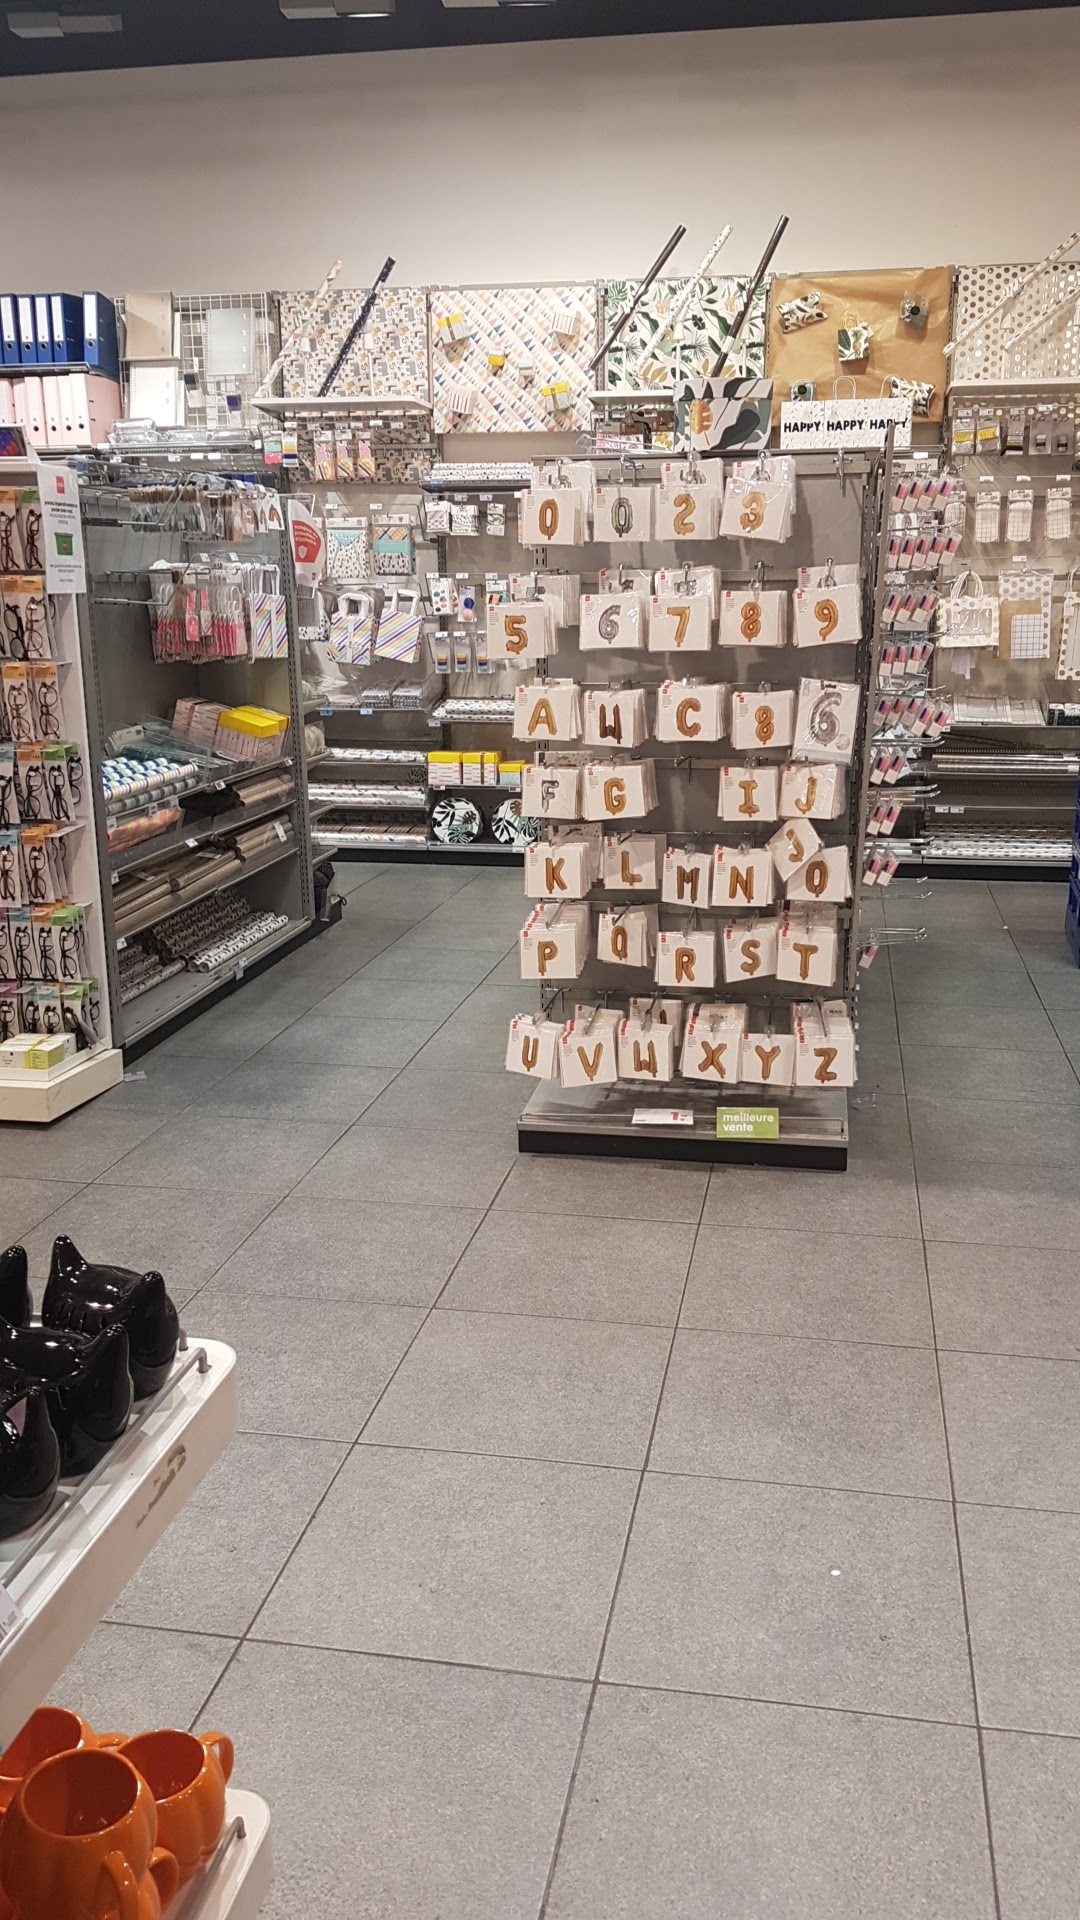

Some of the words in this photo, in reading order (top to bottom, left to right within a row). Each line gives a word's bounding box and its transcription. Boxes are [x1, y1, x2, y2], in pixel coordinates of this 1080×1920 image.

[783, 420, 822, 433] HAPPY
[826, 419, 865, 432] HAPPY
[673, 493, 696, 536] 2
[740, 491, 767, 533] 3
[504, 614, 529, 655] 5
[598, 603, 621, 645] 6
[666, 606, 691, 648] 7
[740, 600, 762, 643] 8
[814, 598, 839, 642] 9
[528, 697, 558, 736] A
[676, 697, 702, 738] C
[754, 704, 775, 745] 8
[807, 691, 843, 747] 6
[541, 779, 560, 813] F
[603, 777, 627, 816] G
[738, 779, 760, 817] I
[794, 776, 818, 814] J
[545, 856, 568, 894] K
[620, 850, 644, 887] L
[676, 864, 701, 904] M
[728, 864, 755, 903] N
[537, 940, 559, 977] P
[675, 947, 696, 984] R
[740, 939, 762, 976] S
[793, 942, 819, 982] T
[521, 1035, 540, 1072] U
[577, 1041, 604, 1081] V
[633, 1039, 658, 1078] W
[697, 1040, 728, 1079] X
[755, 1045, 781, 1081] Y
[814, 1047, 838, 1084] Z
[722, 1112, 775, 1123] meilleure
[722, 1122, 754, 1132] vente
